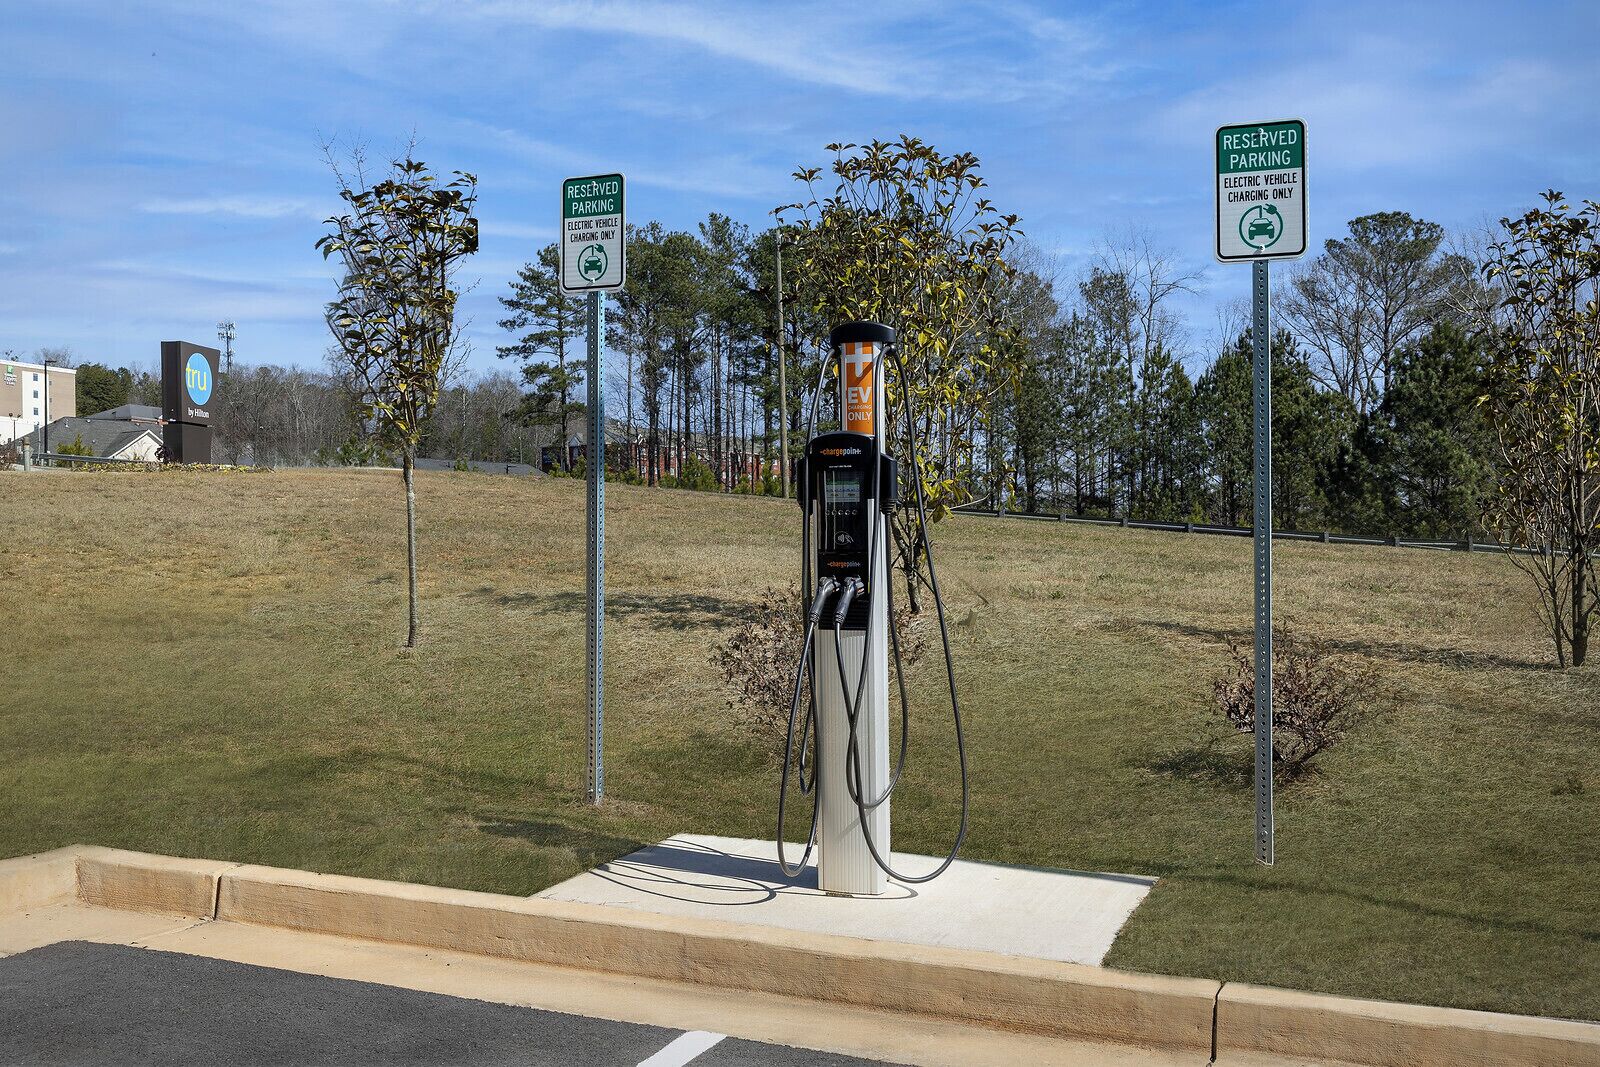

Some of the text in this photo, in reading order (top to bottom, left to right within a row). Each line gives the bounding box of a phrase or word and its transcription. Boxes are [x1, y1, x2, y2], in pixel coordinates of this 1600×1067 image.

[1223, 129, 1297, 150] RESERVED
[1230, 150, 1291, 169] PARKING
[1224, 172, 1298, 189] ELECTRIC VEHICLE
[567, 181, 619, 199] RESERVED
[1228, 187, 1294, 203] CHARGING ONLY
[572, 198, 614, 215] PARKING
[568, 217, 618, 231] ELECTRIC VEHICLE
[570, 229, 616, 243] CHARGING ONLY
[186, 362, 207, 391] tru
[848, 386, 872, 403] EV
[187, 406, 210, 418] by Hilton
[848, 411, 872, 421] ONLY
